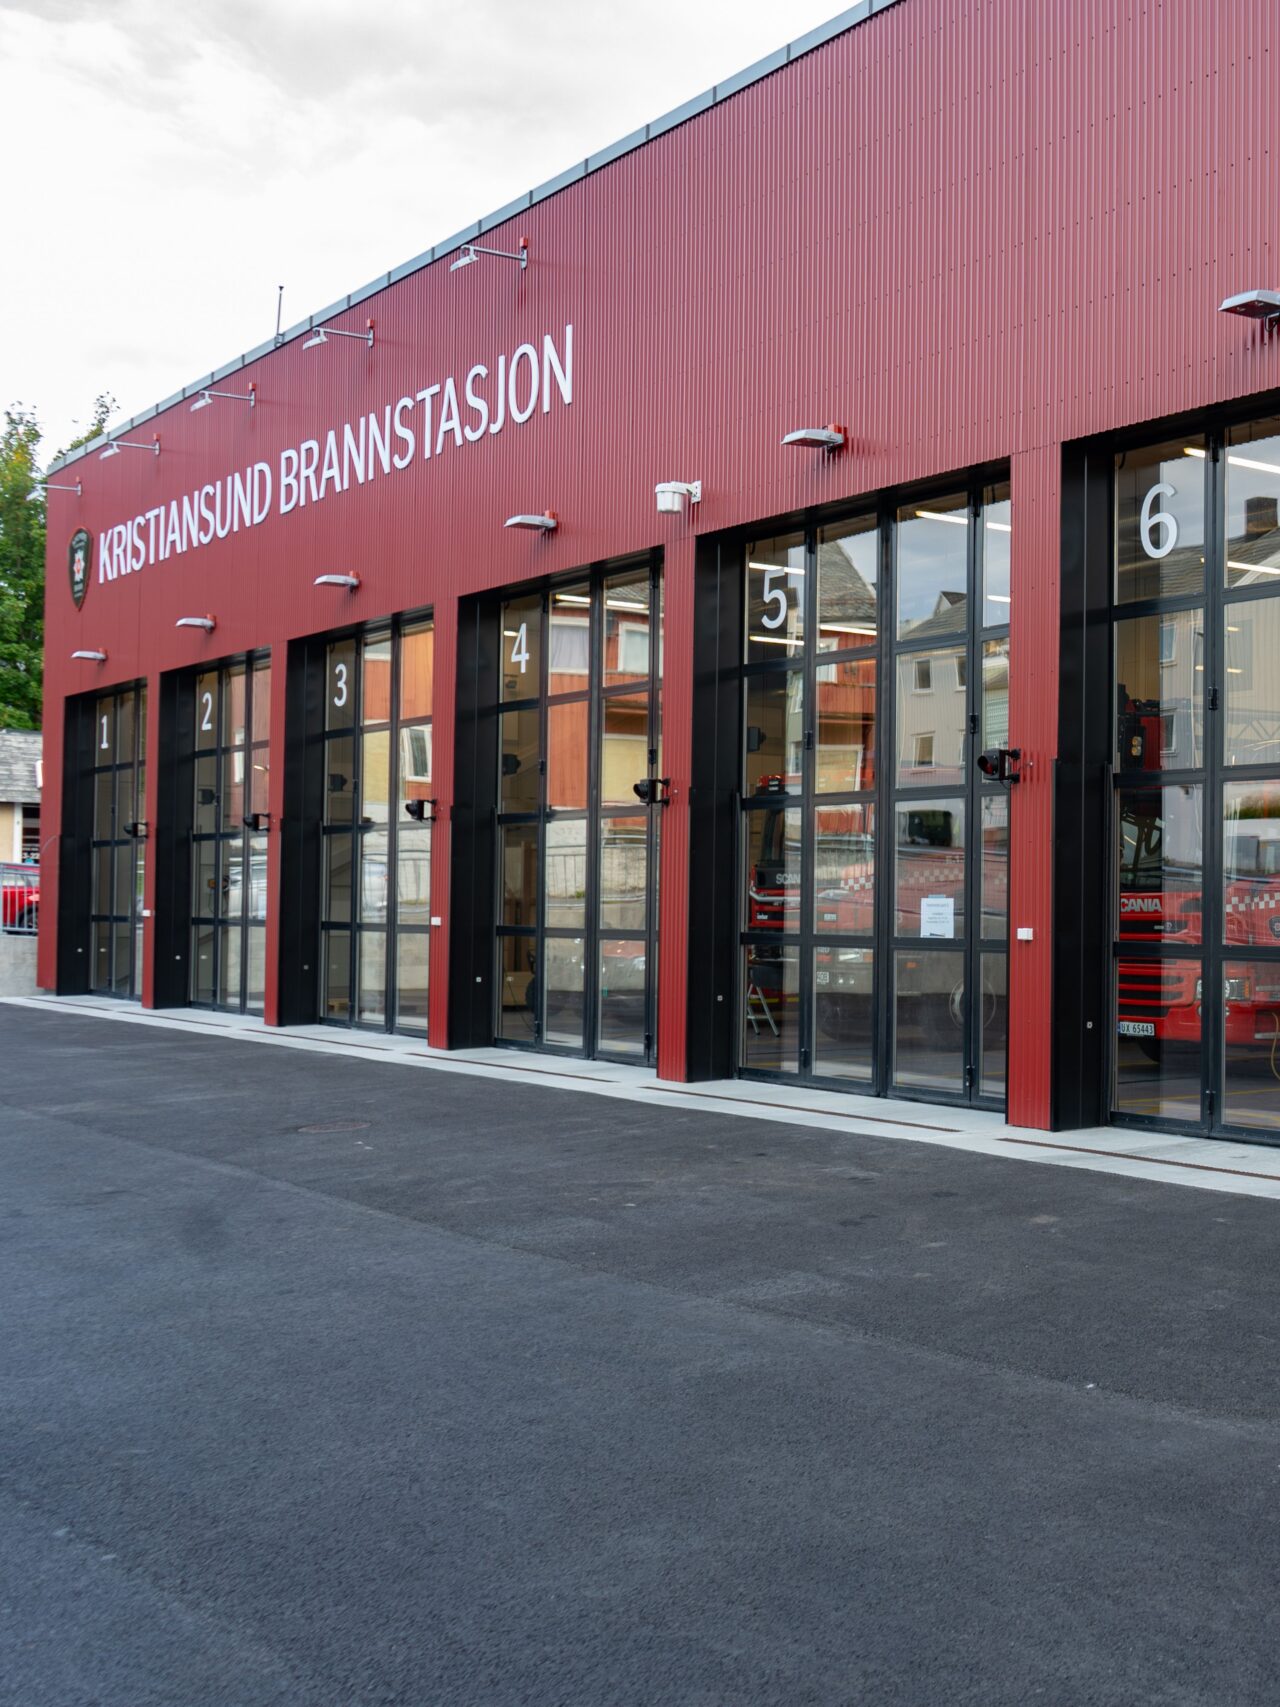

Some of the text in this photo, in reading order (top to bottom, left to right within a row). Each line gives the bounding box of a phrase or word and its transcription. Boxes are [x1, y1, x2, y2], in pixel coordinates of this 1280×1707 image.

[98, 324, 573, 584] KRISTIANSUND BRANNSTASJON
[1140, 483, 1178, 558] 6
[761, 568, 787, 629] 5
[511, 622, 529, 673] 4
[334, 663, 347, 707] 3
[101, 715, 109, 749] 1
[202, 692, 212, 731] 2
